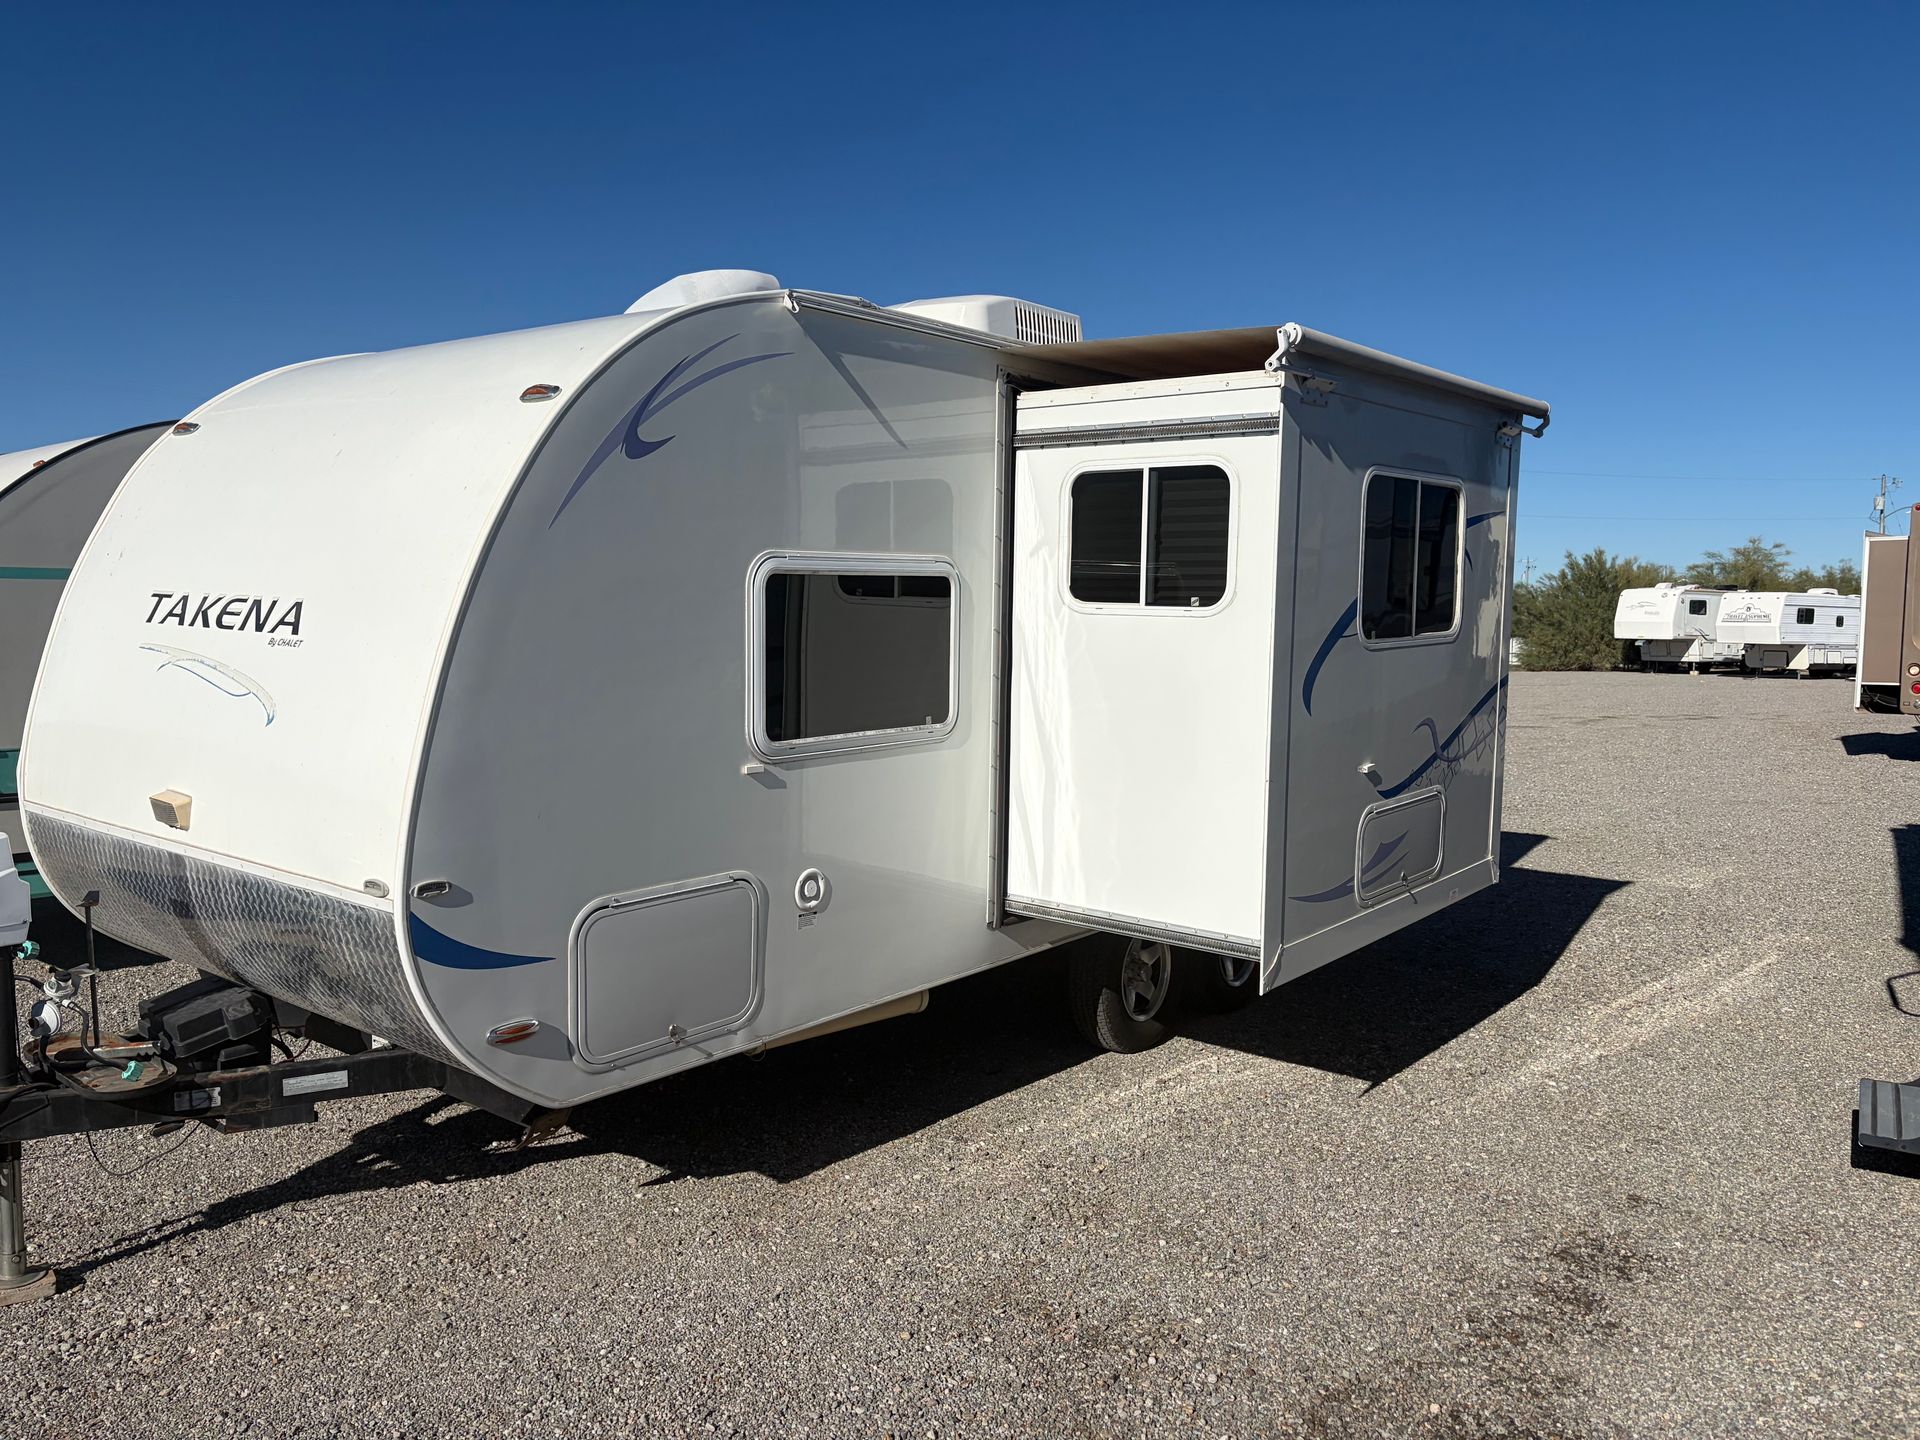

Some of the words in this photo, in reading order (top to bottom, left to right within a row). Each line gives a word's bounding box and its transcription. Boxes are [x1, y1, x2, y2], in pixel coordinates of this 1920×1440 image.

[146, 591, 304, 636] TAKENA
[268, 637, 277, 647] By
[277, 638, 304, 648] CHALET
